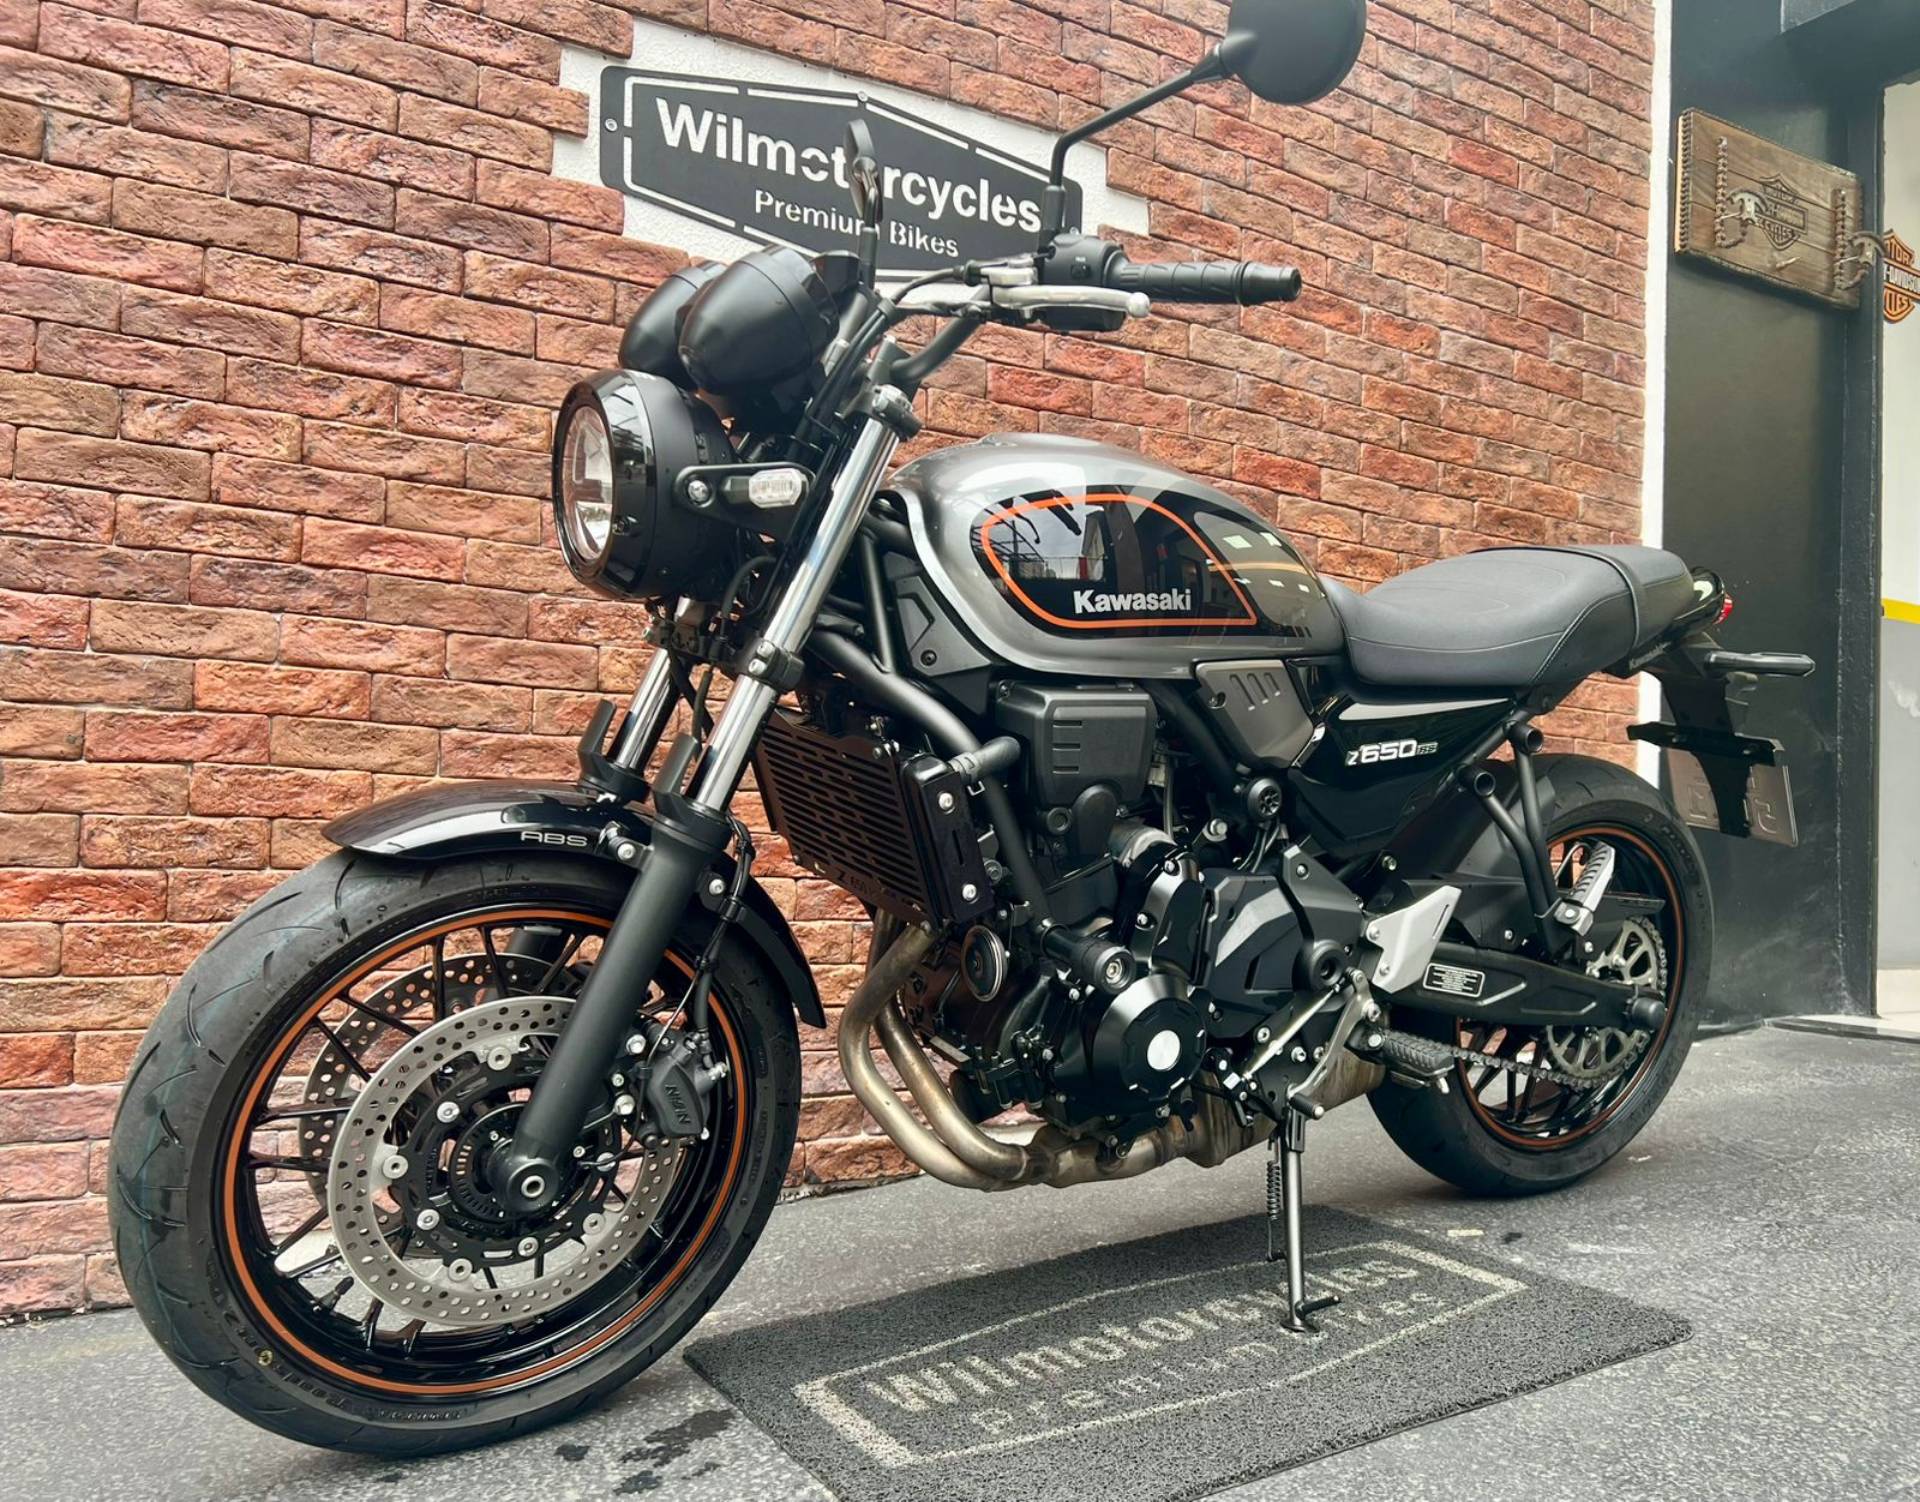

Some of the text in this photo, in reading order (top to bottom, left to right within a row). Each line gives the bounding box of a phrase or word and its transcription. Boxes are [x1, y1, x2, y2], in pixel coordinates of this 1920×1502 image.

[655, 96, 1042, 234] Wilmotrcycles
[890, 220, 960, 258] Bikes
[1073, 588, 1192, 614] Kawasaki
[520, 831, 588, 847] ABS
